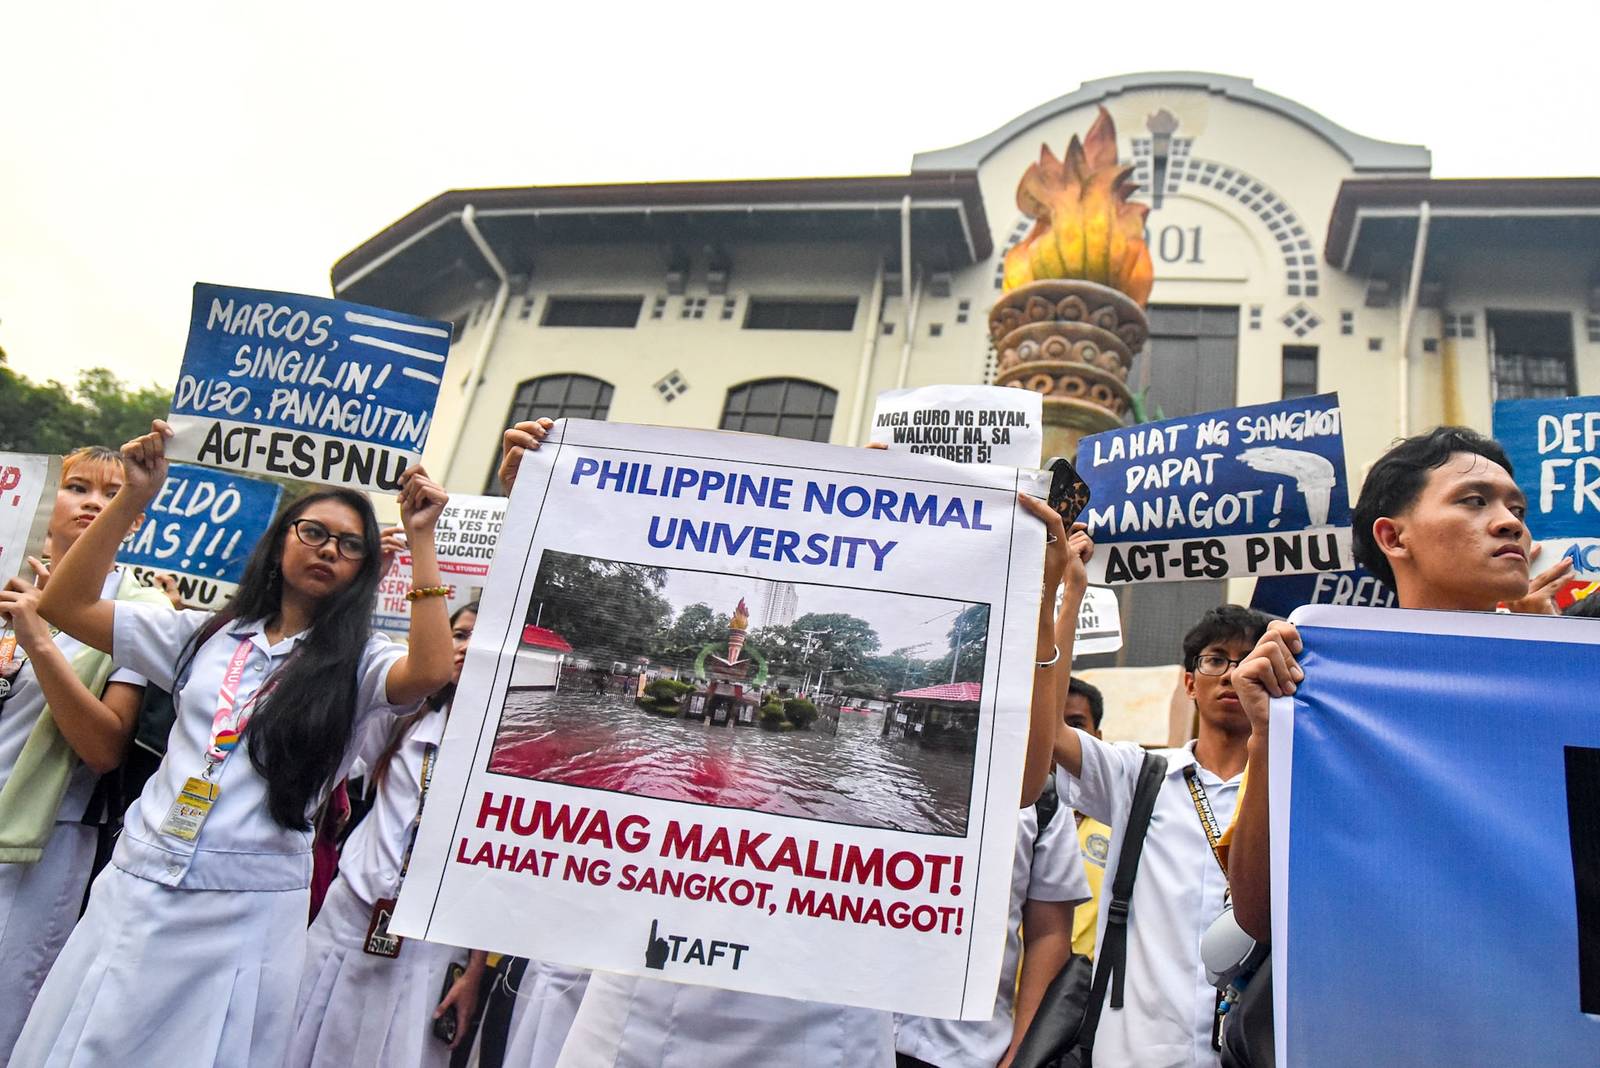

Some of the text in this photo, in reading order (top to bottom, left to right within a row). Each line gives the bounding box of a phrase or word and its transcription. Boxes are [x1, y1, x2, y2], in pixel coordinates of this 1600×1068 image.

[206, 298, 339, 352] MARCOS,
[228, 345, 392, 401] SINGILIN!
[176, 375, 428, 453] DU30, PANAGUTIN!
[877, 410, 1030, 429] MGA GURO NG BAYAN,
[893, 427, 1011, 448] WALKOUT NA, SA
[1093, 408, 1341, 467] LAHAT NG SANGKOT
[197, 421, 408, 490] ACT-ES PNU
[977, 446, 992, 463] 5!
[1126, 454, 1224, 493] DAPAT
[464, 509, 488, 521] THE
[571, 457, 991, 532] PHILIPPINE NORMAL
[459, 520, 483, 532] YES
[648, 515, 898, 572] UNIVERSITY
[1105, 533, 1341, 584] ACT-ES PNU
[173, 575, 218, 604] NU
[384, 597, 407, 612] THE
[476, 792, 964, 896] HUWAG MAKALIMOT!
[457, 838, 964, 936] LAHAT NG SANGKOT, MANAGOT!
